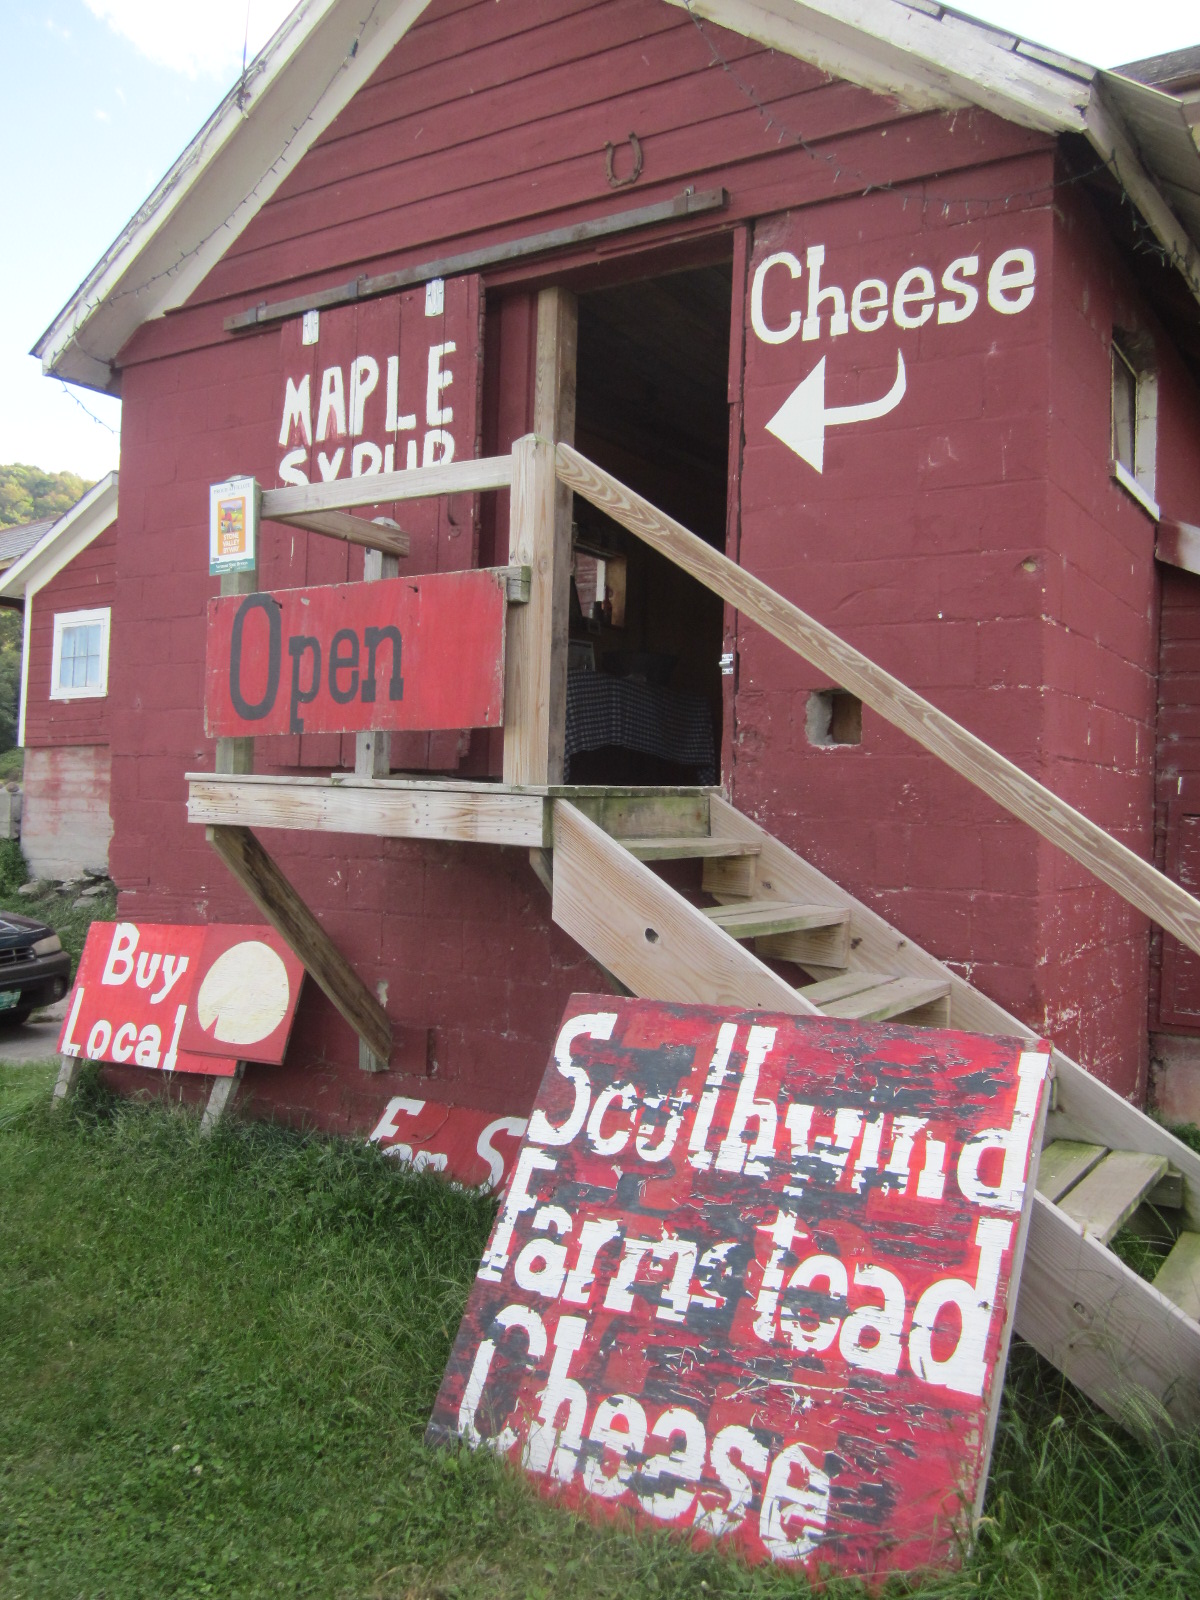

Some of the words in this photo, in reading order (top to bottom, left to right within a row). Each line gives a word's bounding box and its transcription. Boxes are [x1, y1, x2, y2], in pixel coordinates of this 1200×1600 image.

[751, 245, 1036, 344] Cheese
[278, 341, 457, 447] MAPLE
[222, 538, 240, 548] VALLEY
[222, 546, 239, 554] BYWAY
[223, 532, 239, 541] STONE
[230, 593, 404, 733] Open
[102, 922, 190, 1004] Buy
[61, 988, 187, 1071] Local
[458, 1303, 831, 1560] Cheese
